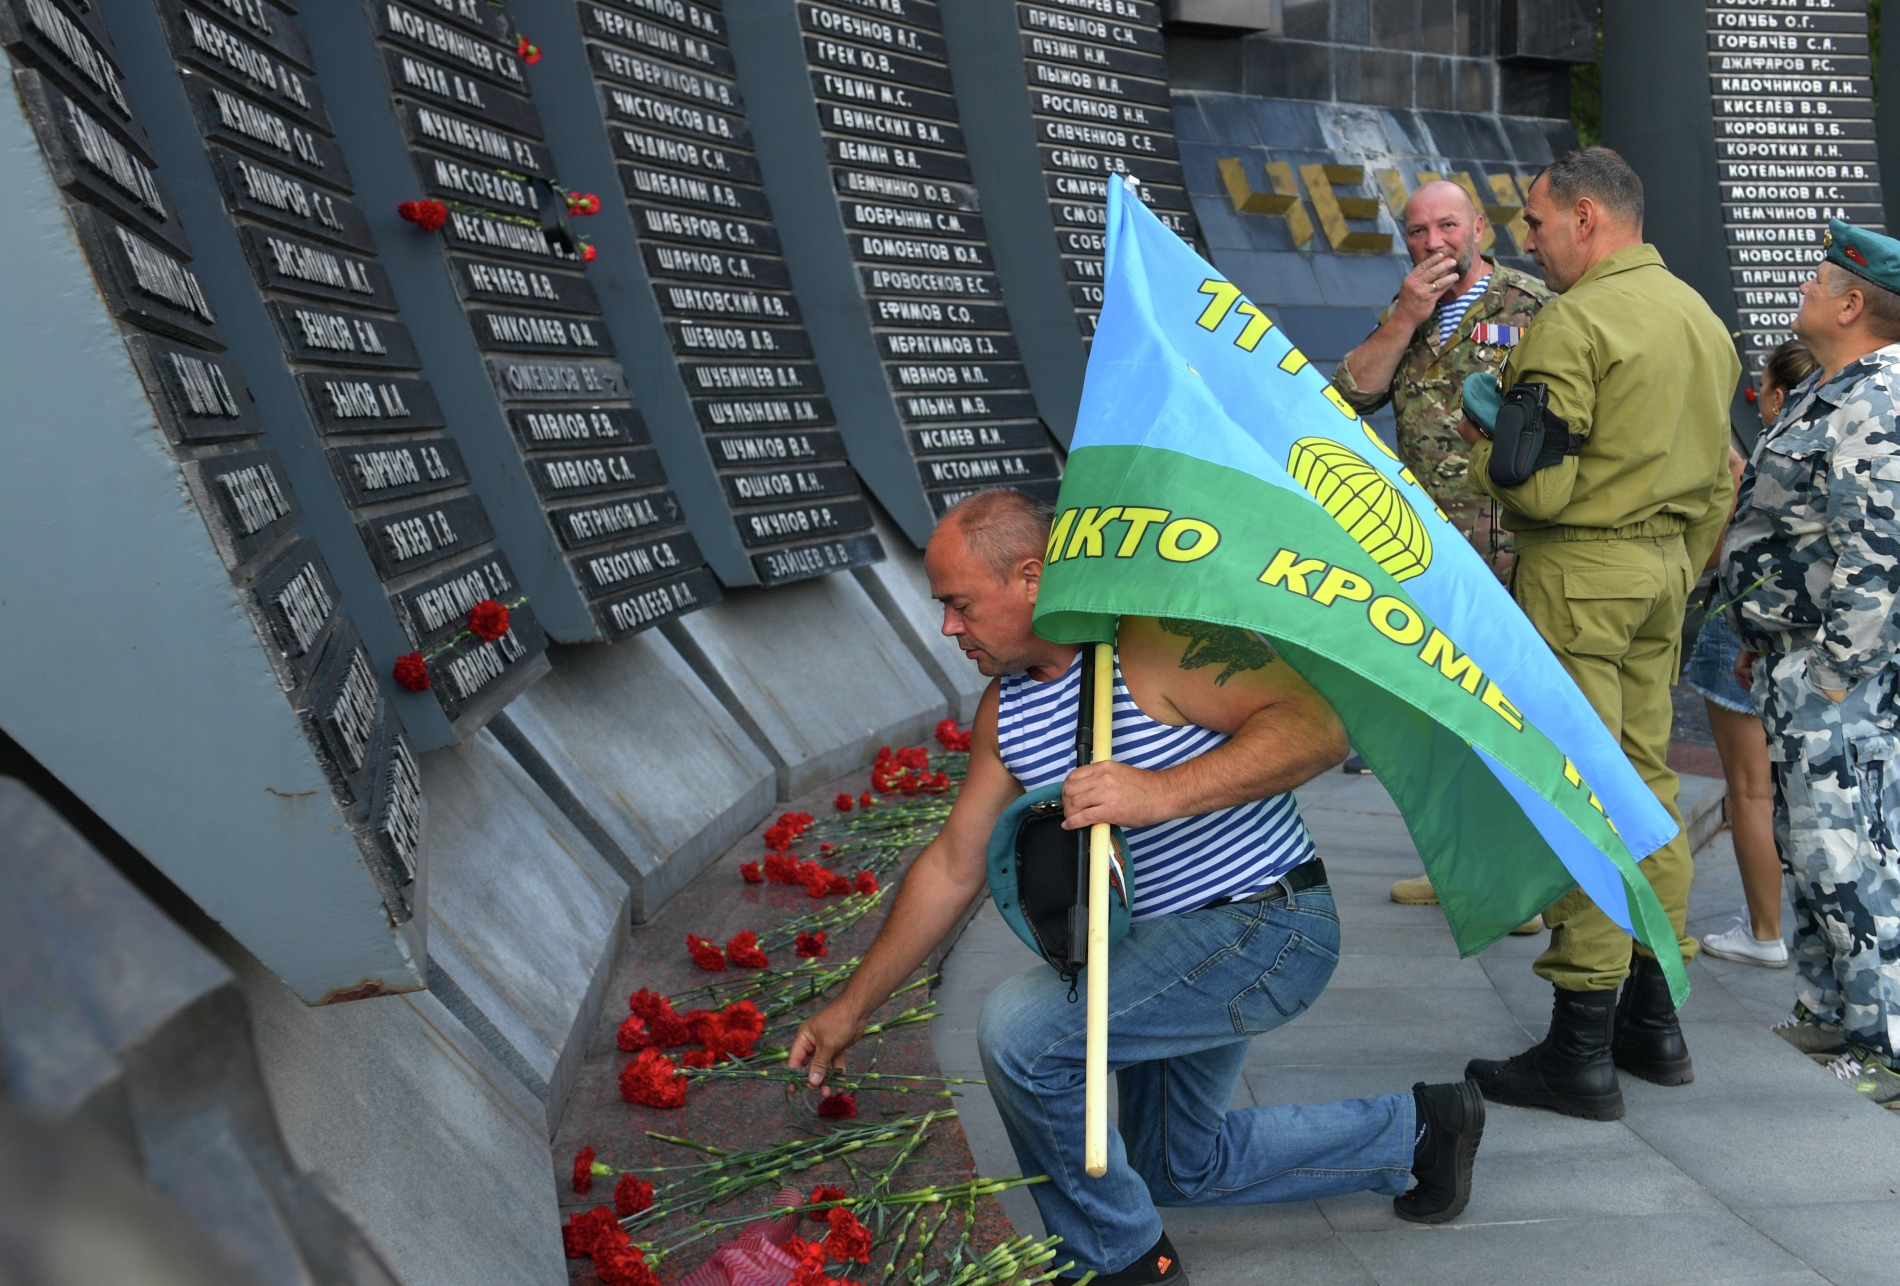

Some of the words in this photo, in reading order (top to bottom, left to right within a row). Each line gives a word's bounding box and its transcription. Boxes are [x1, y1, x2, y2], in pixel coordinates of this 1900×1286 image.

[594, 9, 679, 53] ЧЕРКАШИН
[811, 8, 892, 42] ГОРБУНОВ
[1029, 9, 1107, 37] ПРИБЫЛОВ
[1716, 14, 1778, 27] ГОЛУБЬ
[387, 5, 493, 70] МОРДВИНЦЕВ
[1033, 38, 1078, 58] ПУЗИН
[818, 42, 856, 64] ГРЕК
[1722, 55, 1804, 70] ДЖАФАРОВ
[403, 57, 450, 96] МУХА
[602, 51, 701, 96] ЧЕТВЕРИКОВ
[1037, 65, 1092, 88] ПЫЖОВ
[1721, 78, 1822, 92] КАДОЧНИКОВ
[824, 75, 875, 100] ГУДИН
[613, 91, 703, 130] ЧИСТОУСОВ
[1042, 94, 1118, 119] РОСЛЯКОВ
[833, 108, 911, 136] ДВИНСКИХ
[1725, 121, 1808, 135] КОРОВКИН
[418, 108, 511, 160] МУХИБУЛИН
[1047, 123, 1126, 147] САВЧЕНКОВ
[624, 132, 699, 165] ЧУДИНОВ
[839, 142, 889, 163] ДЕМИН
[1051, 150, 1098, 170] САЙКО
[1727, 142, 1808, 156] КОРОТКИХ
[1729, 165, 1836, 177] КОТЕЛЬНИКОВ
[435, 160, 525, 206] МЯСОЕДОВ
[634, 170, 709, 201] ШАБАЛИН
[1057, 178, 1107, 196] СМИРН
[1732, 185, 1812, 199] МОЛОКОВ
[646, 210, 722, 240] ШАБУРОВ
[855, 205, 932, 228] ДОБРЫНИН
[1732, 207, 1817, 220] НЕМЧИНОВ
[1736, 229, 1816, 241] НИКОЛАЕВ
[863, 237, 949, 260] ДОМОЕНТОВ
[657, 248, 722, 274] ШАРКОВ
[469, 264, 529, 295] НЕЧАЕВ
[873, 271, 963, 292] ДРОВОСЕКОВ
[669, 287, 760, 314] ШАХОВСКИЙ
[879, 302, 942, 320] ЕФИМОВ
[487, 314, 567, 344] НИКОЛАЕВ
[681, 327, 746, 349] ШЕВЦОВ
[889, 336, 972, 353] ИБРАГИМОВ
[696, 367, 775, 387] ШУБИНЦЕВ
[899, 367, 957, 384] ИВАНОВ
[709, 402, 791, 423] ШУЛЫНДИН
[909, 398, 956, 415] ИЛЬИН
[527, 414, 589, 439] ПАВЛОВ
[721, 438, 786, 459] ШУМКОВ
[920, 429, 975, 448] ИСЛАЕВ
[546, 459, 607, 488] ПАВЛОВ
[932, 460, 1000, 480] ИСТОМИН
[735, 474, 793, 497] ЮШКОВ
[569, 504, 637, 539] ПЕТРИКОВ
[751, 511, 809, 536] ЯКУПОВ
[590, 549, 653, 585] ПЕХОТИН
[767, 548, 824, 577] ЗАЙЦЕВ
[611, 588, 673, 629] ПОЗДЕЕВ
[1257, 547, 1525, 732] КРОМЕ
